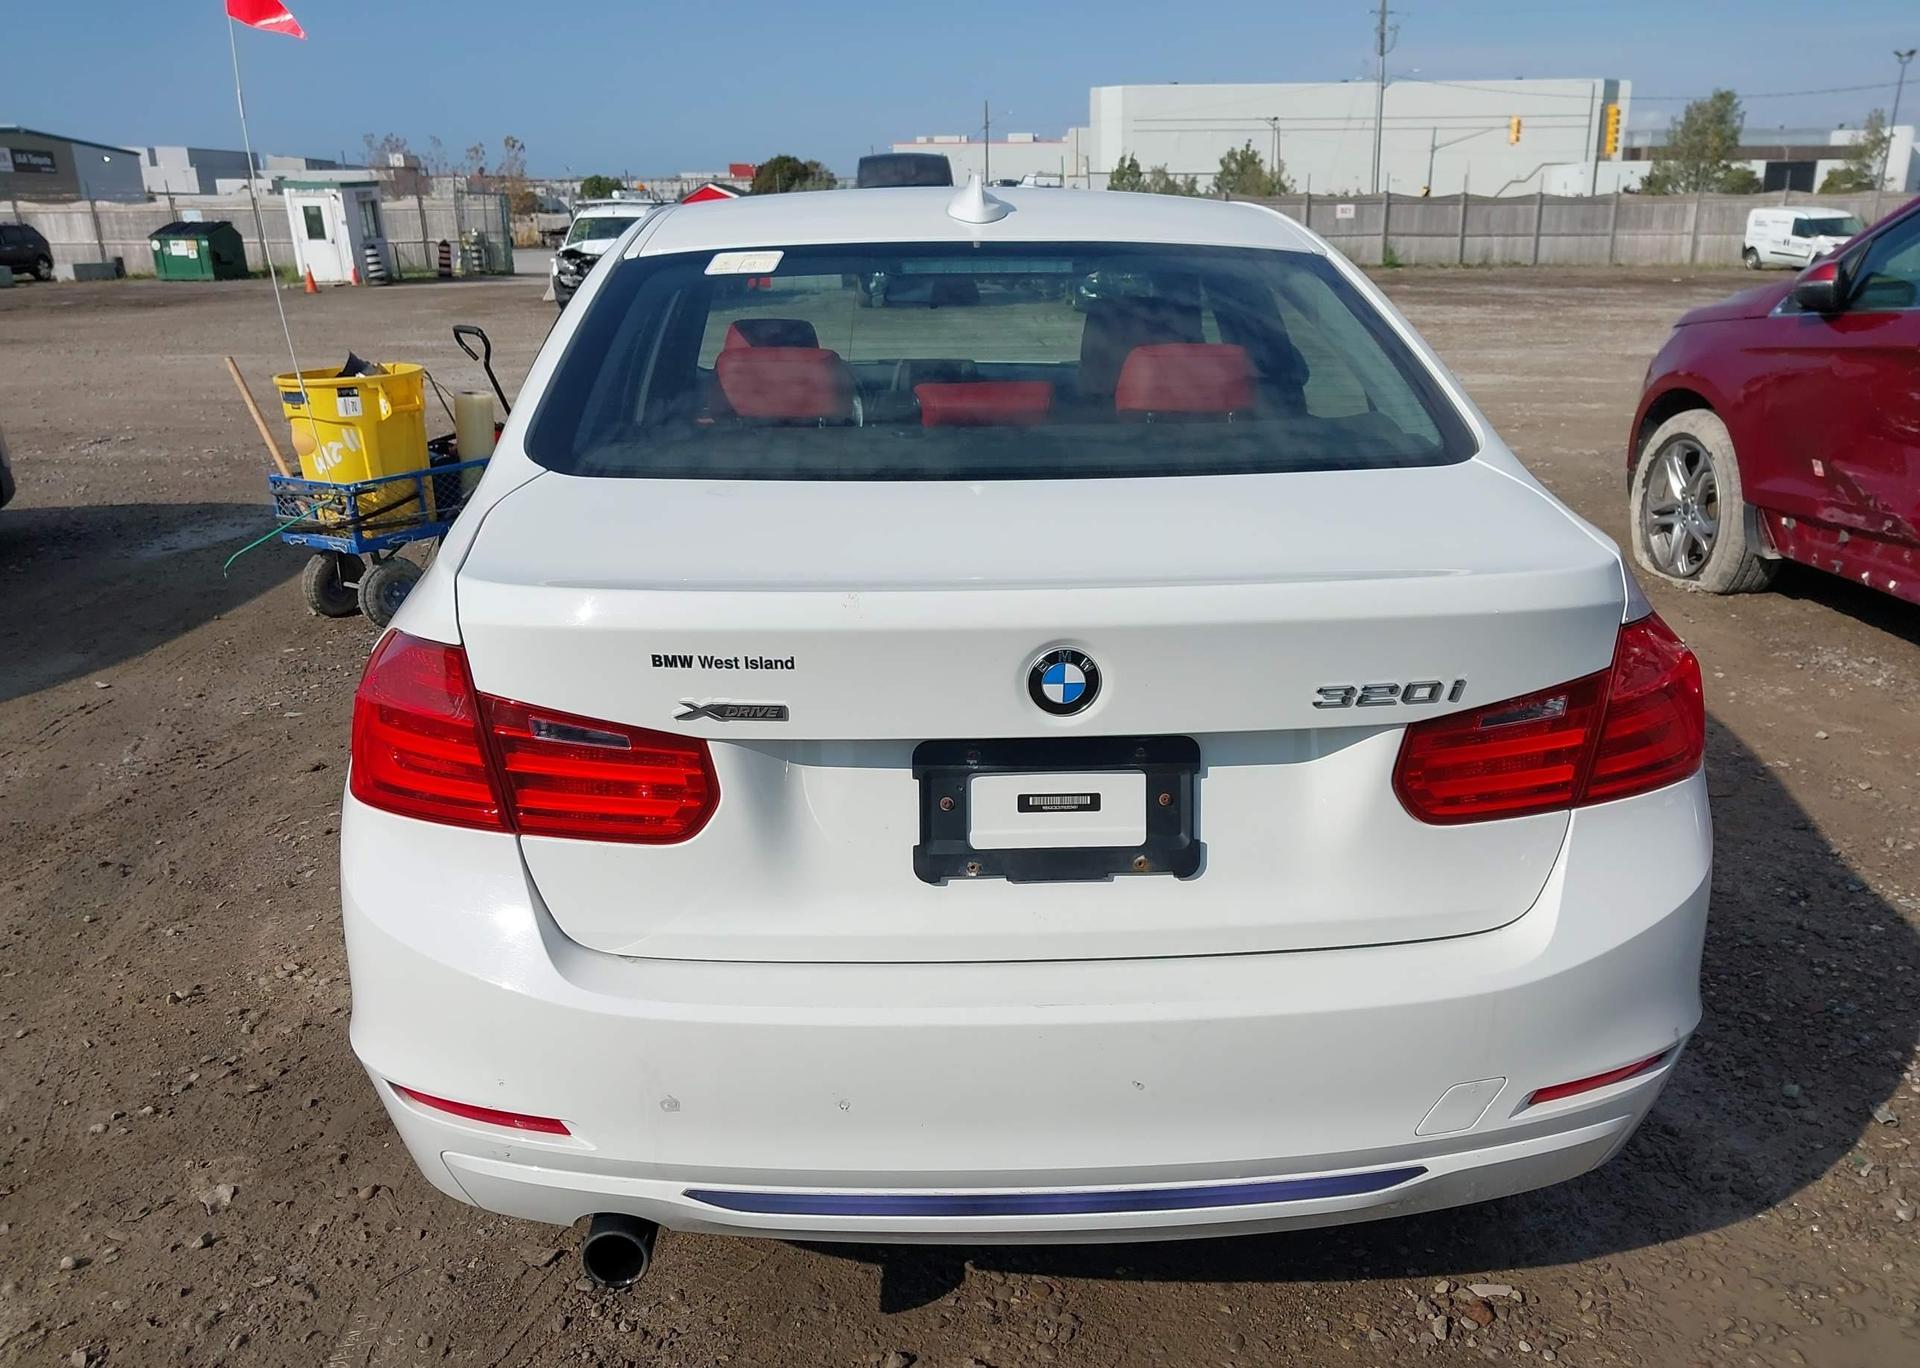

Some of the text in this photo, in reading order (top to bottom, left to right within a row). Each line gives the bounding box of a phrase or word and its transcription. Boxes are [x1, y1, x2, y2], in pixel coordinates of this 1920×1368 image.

[651, 654, 796, 670] BMW West Island
[1035, 650, 1095, 673] BMW
[1312, 679, 1467, 710] 320i
